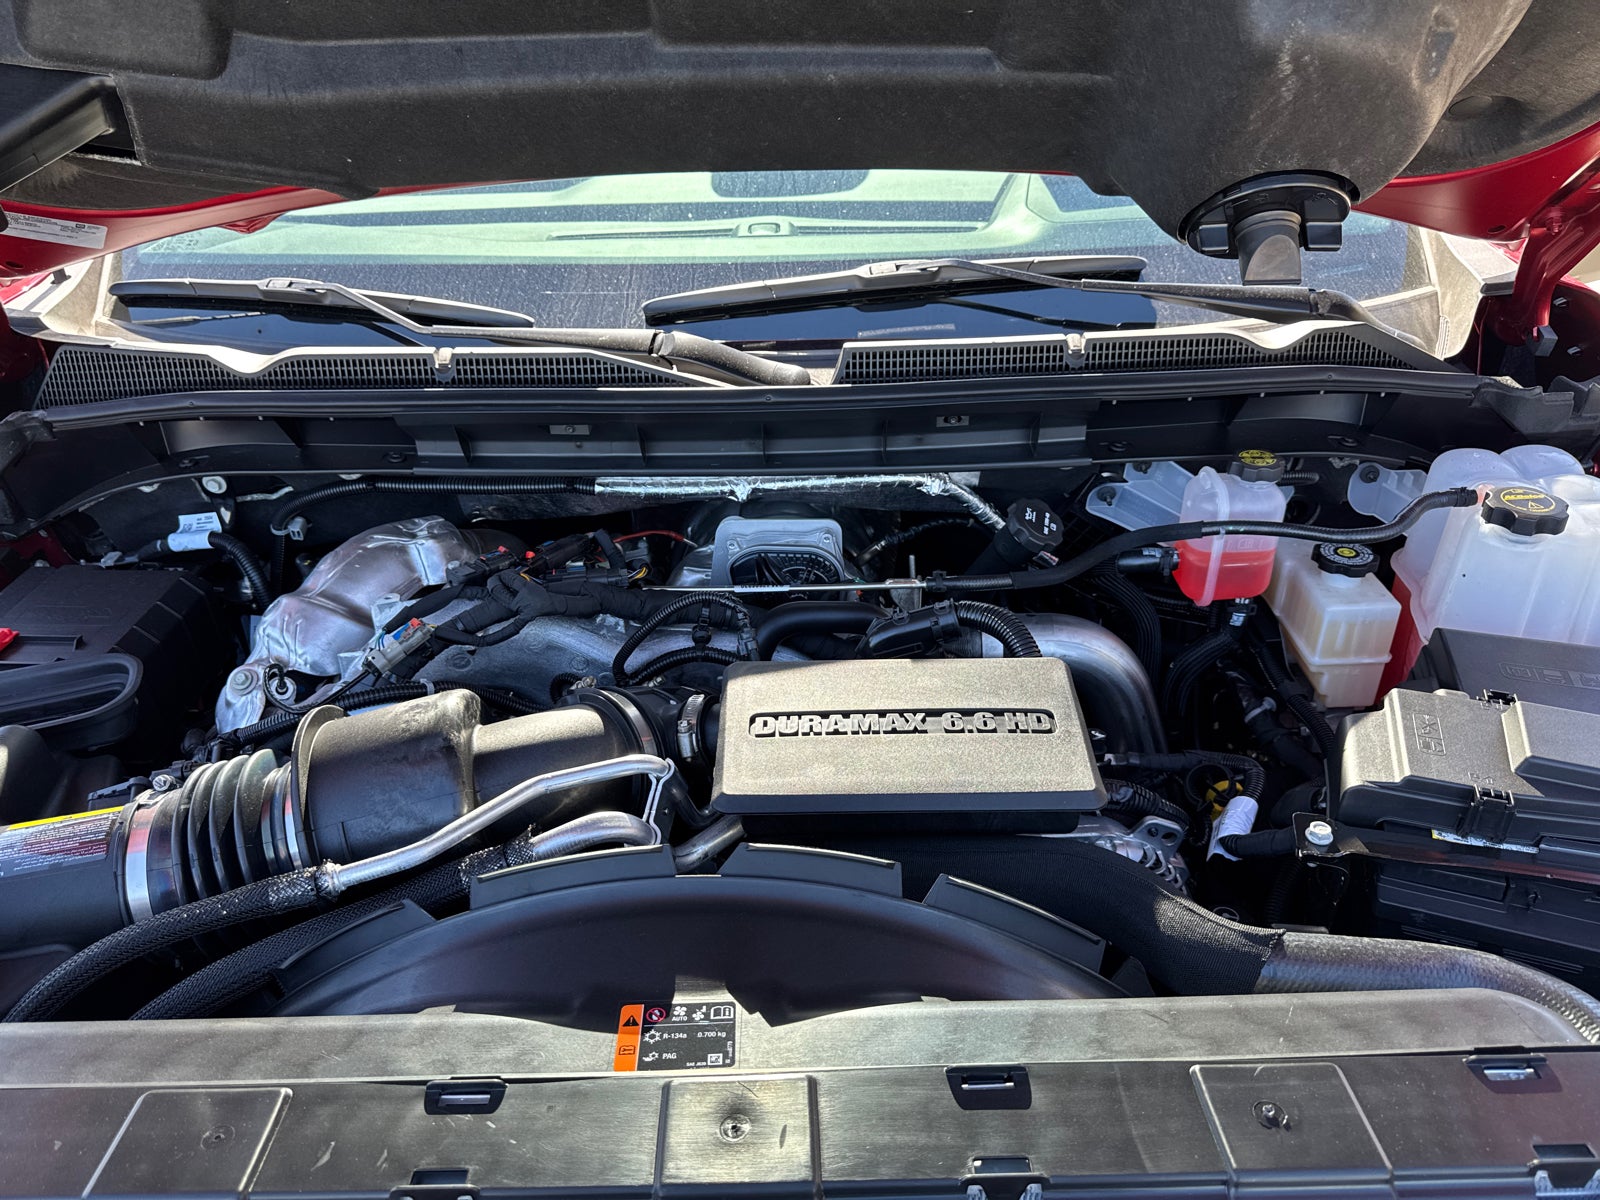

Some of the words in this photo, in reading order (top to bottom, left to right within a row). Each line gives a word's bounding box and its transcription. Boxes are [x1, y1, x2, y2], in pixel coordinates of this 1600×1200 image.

[754, 713, 928, 737] DURAMAX
[941, 712, 998, 734] 6.6
[1004, 712, 1053, 734] HD
[662, 1052, 677, 1060] PAG
